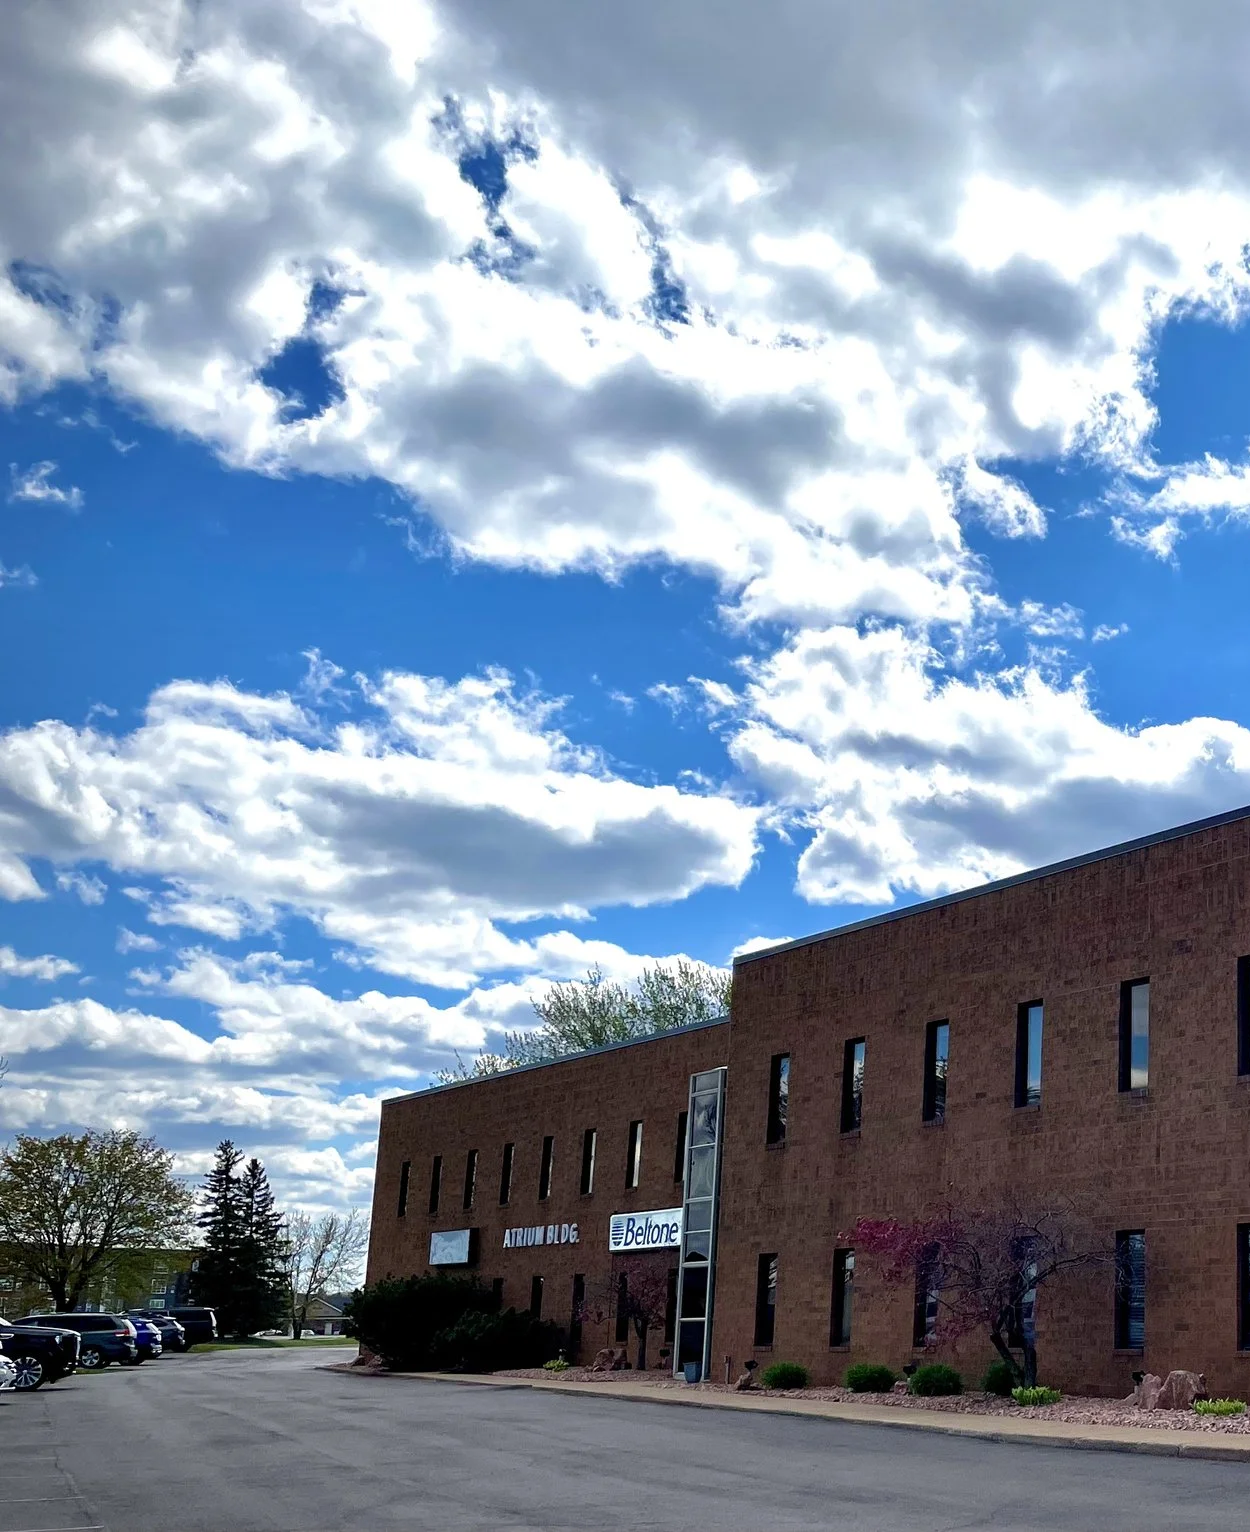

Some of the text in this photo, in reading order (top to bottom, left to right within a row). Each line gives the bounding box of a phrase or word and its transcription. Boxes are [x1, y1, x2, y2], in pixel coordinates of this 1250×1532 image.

[503, 1223, 580, 1248] ATRIUM BLDG.
[624, 1218, 678, 1246] Beltone
